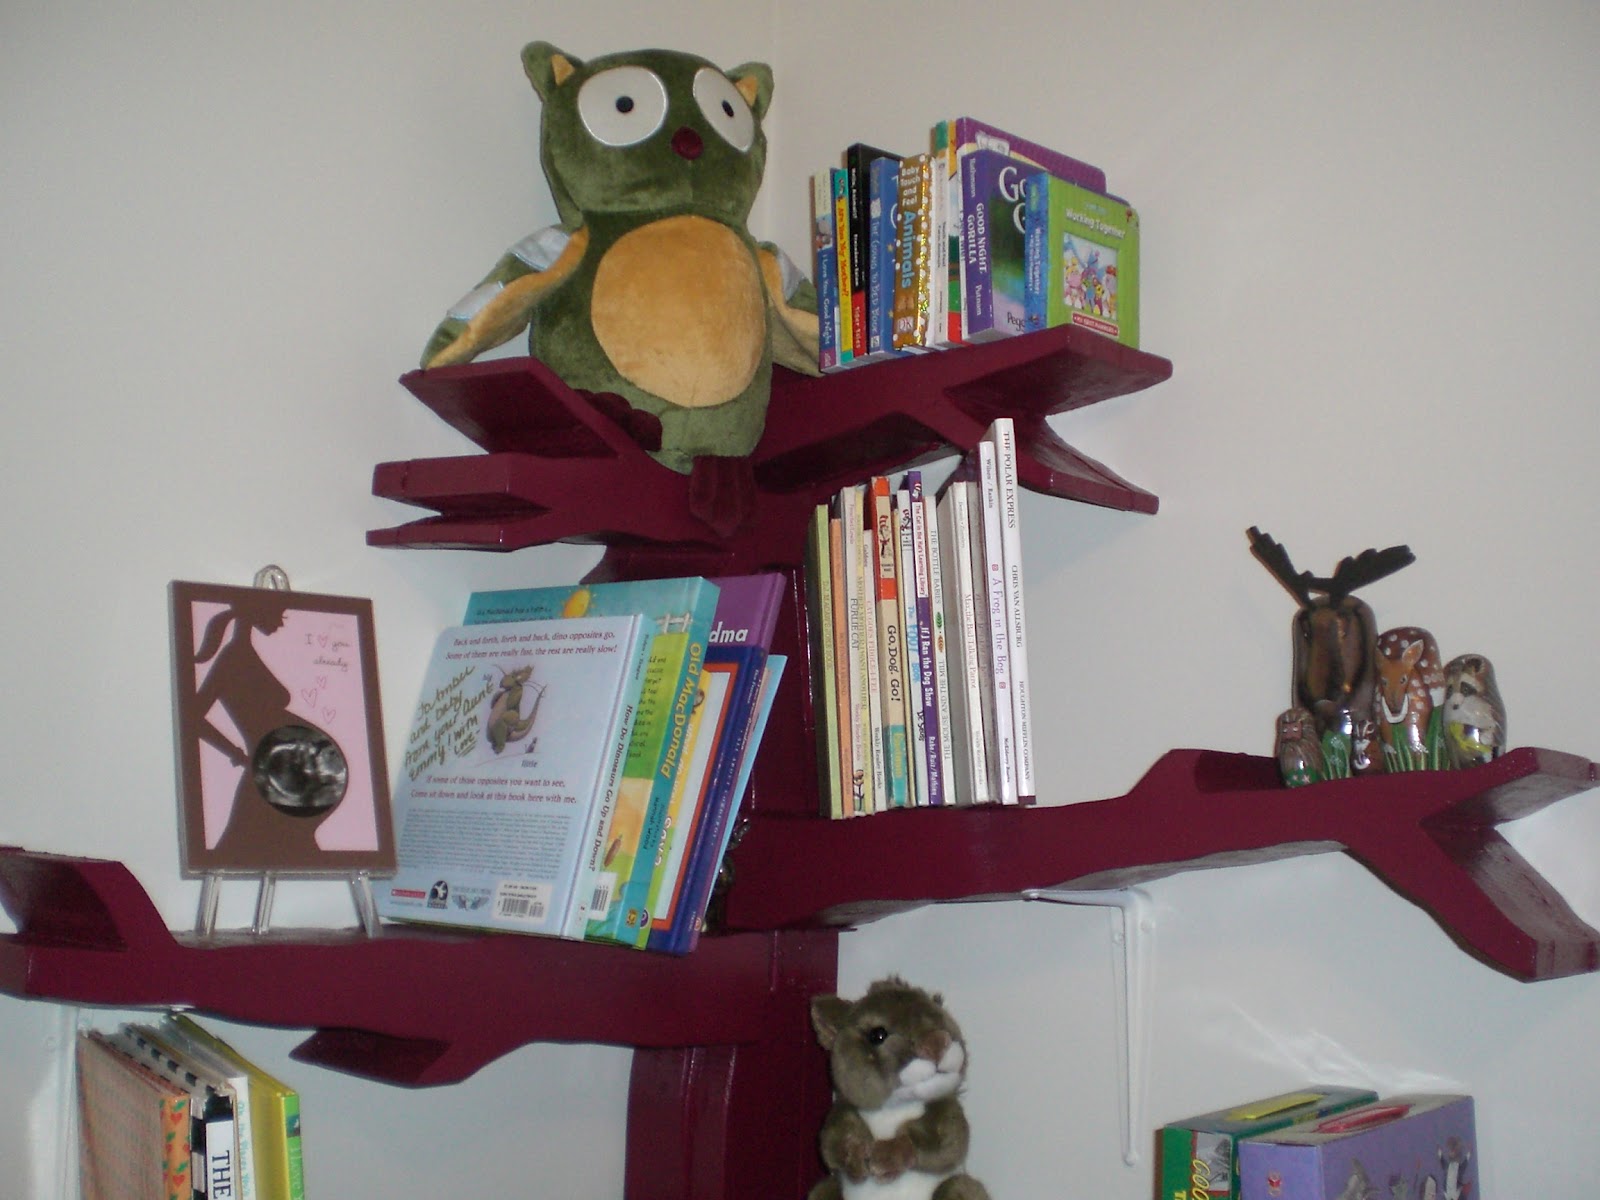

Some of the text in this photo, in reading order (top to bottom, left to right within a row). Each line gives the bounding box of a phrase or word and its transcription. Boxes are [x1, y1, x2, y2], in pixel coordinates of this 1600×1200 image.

[900, 174, 920, 186] Touch
[901, 167, 920, 176] Baby
[902, 195, 918, 206] Feel
[903, 186, 917, 195] and
[871, 222, 880, 236] THE
[976, 203, 986, 234] GOOD
[1065, 208, 1095, 228] Working
[1095, 220, 1126, 239] Together
[901, 211, 916, 288] Animals
[967, 215, 976, 264] GORILLA
[871, 284, 880, 305] BED
[974, 285, 983, 316] Putnam
[871, 308, 880, 334] BOOK
[823, 321, 832, 344] Night
[1004, 453, 1012, 485] POLAR
[1006, 488, 1015, 528] EXPRESS
[917, 554, 925, 576] Learning
[932, 547, 940, 575] BOTTLE
[919, 578, 927, 595] Library
[850, 598, 859, 631] FURLIE
[519, 634, 531, 642] and
[552, 632, 567, 640] dino
[569, 630, 602, 640] opposites
[604, 632, 615, 640] go,
[921, 627, 929, 635] If
[992, 578, 1006, 674] A Frog in the Bog
[1014, 608, 1022, 648] ALLSBURG
[304, 634, 351, 652] I you
[908, 624, 919, 652] FOOT
[922, 641, 930, 655] Ran
[464, 651, 470, 659] of
[500, 649, 519, 658] really
[547, 647, 561, 655] rest
[575, 646, 594, 654] really
[597, 644, 618, 653] slow!
[312, 656, 349, 672] already
[923, 657, 931, 669] the
[938, 661, 946, 677] MILL
[923, 671, 932, 685] Dog
[969, 667, 977, 689] Parrot
[891, 679, 901, 701] Go!
[925, 688, 933, 707] Show
[661, 642, 702, 778] Old MacDonald
[1018, 681, 1030, 781] HOUGHTON MIFFLIN COMPANY
[459, 776, 475, 784] those
[477, 776, 507, 786] opposites
[510, 778, 522, 787] you
[524, 779, 541, 787] want
[588, 705, 633, 871] How Do Dinosaurs Go Up and Down?
[411, 790, 428, 798] Come
[438, 790, 455, 798] down
[456, 791, 468, 799] and
[470, 791, 484, 800] look
[486, 792, 493, 800] at
[494, 792, 507, 800] this
[508, 792, 525, 801] book
[528, 794, 544, 802] here
[546, 794, 561, 803] with
[564, 796, 577, 804] me.
[212, 1150, 232, 1200] THE
